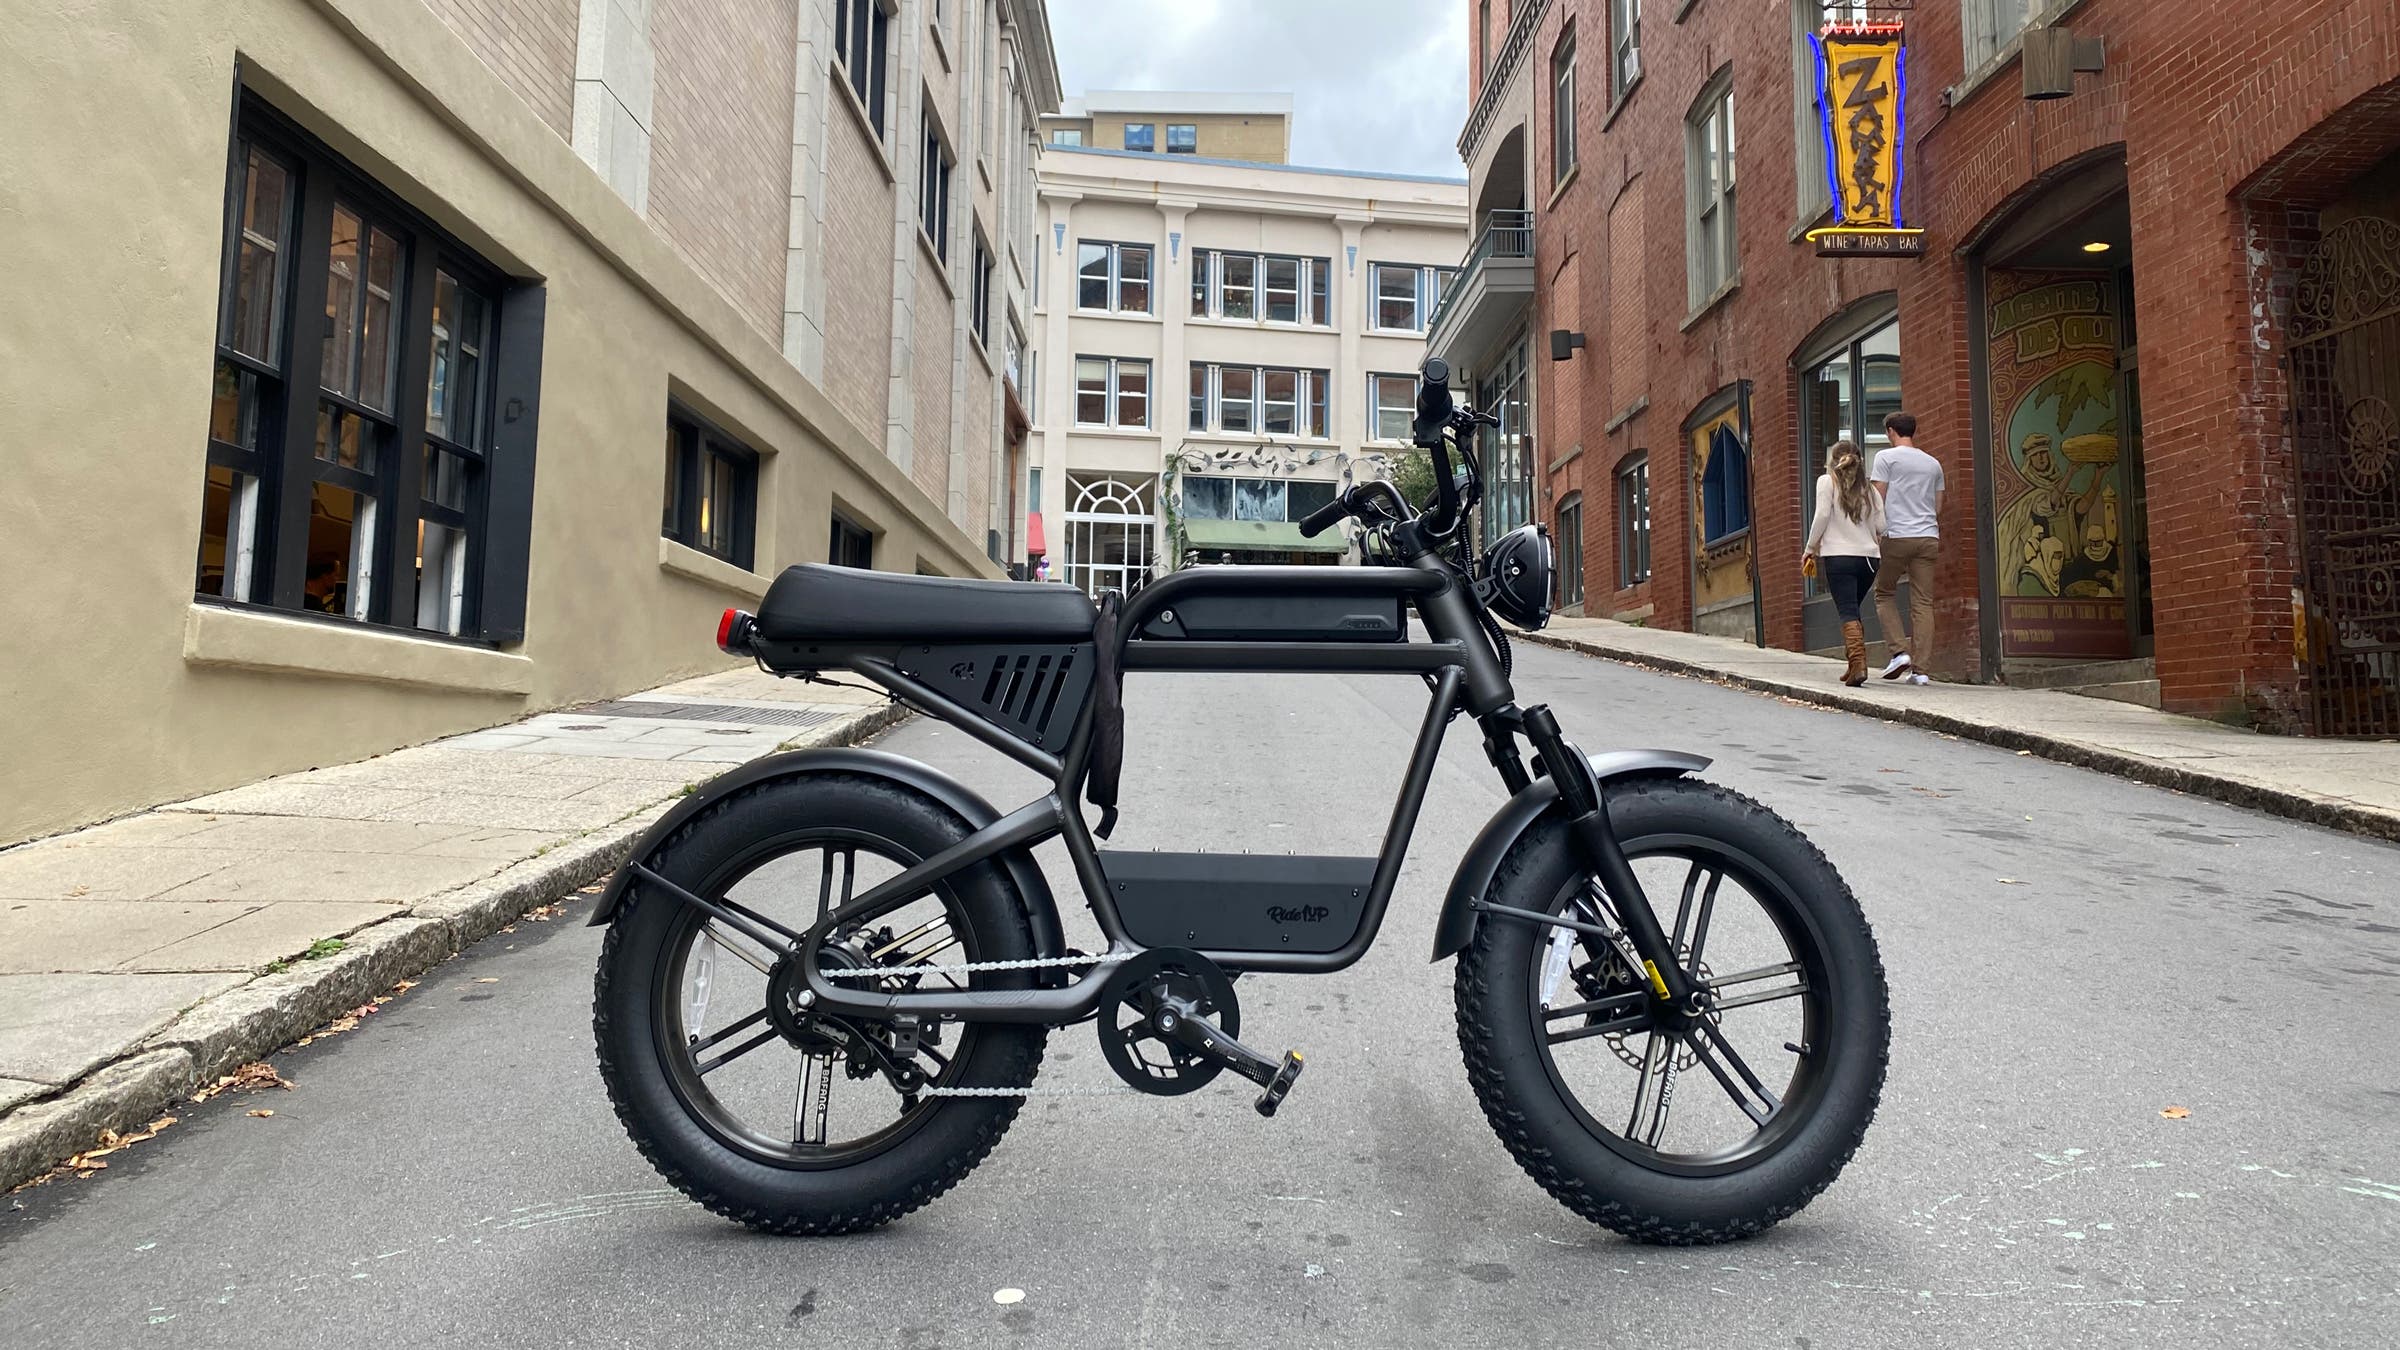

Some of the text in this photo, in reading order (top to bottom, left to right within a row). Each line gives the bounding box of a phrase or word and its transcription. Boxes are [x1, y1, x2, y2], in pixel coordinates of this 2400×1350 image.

[1838, 56, 1888, 217] ZAMBRA
[1823, 234, 1919, 250] WINE TAPAS BAR
[2017, 320, 2059, 362] DE
[818, 1069, 830, 1111] BAFANG
[1662, 1061, 1678, 1106] BAFANG
